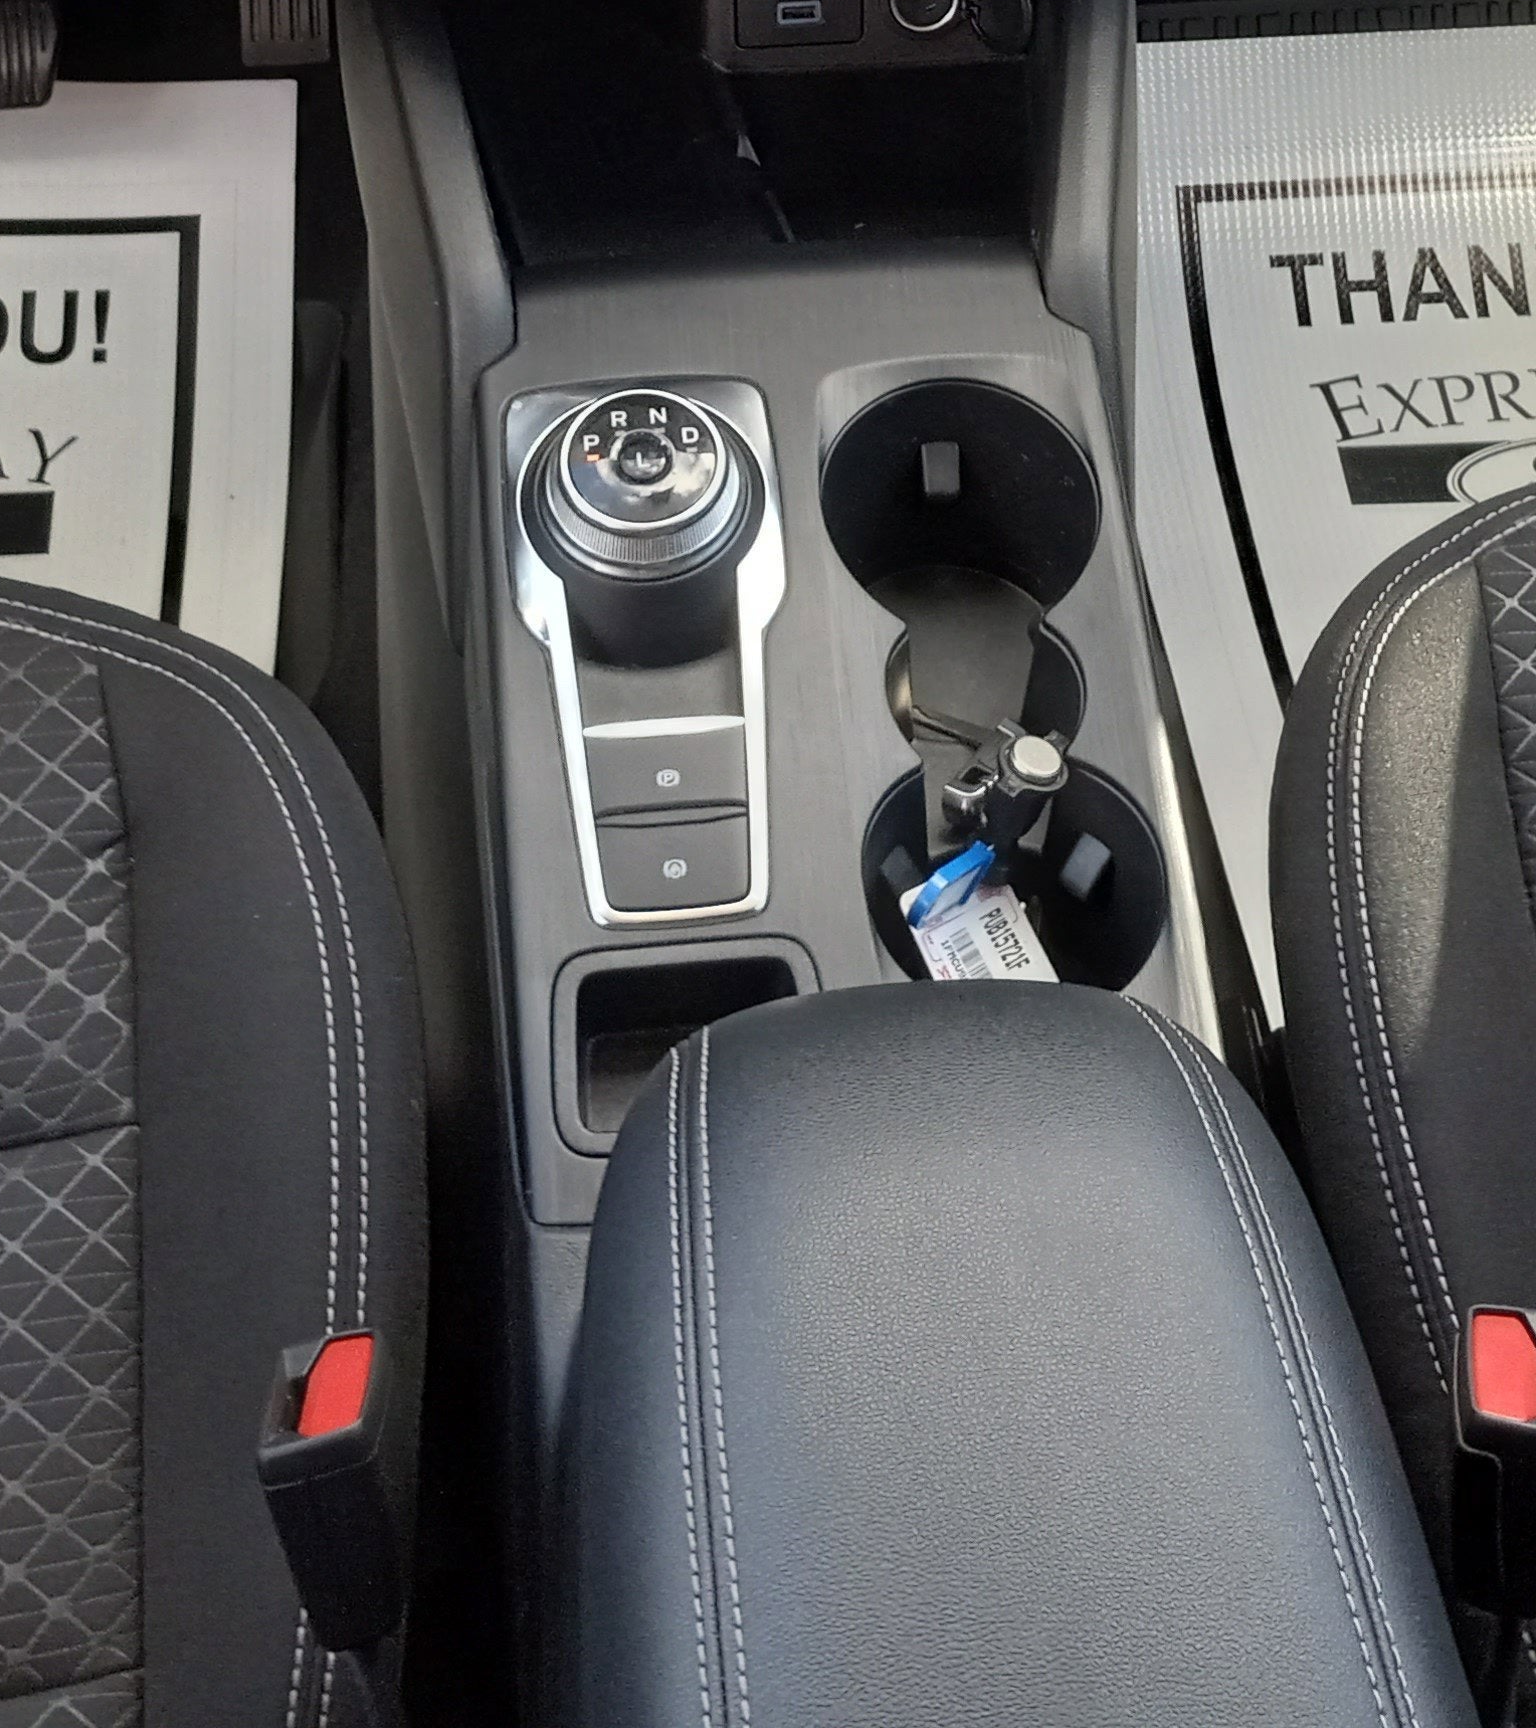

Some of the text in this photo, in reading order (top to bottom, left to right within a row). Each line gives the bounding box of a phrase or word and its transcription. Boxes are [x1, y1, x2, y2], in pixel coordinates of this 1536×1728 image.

[610, 410, 627, 427] R
[649, 406, 668, 424] N
[582, 434, 600, 452] P
[680, 426, 699, 444] D
[636, 451, 650, 469] L
[979, 907, 1031, 971] PUB15721F
